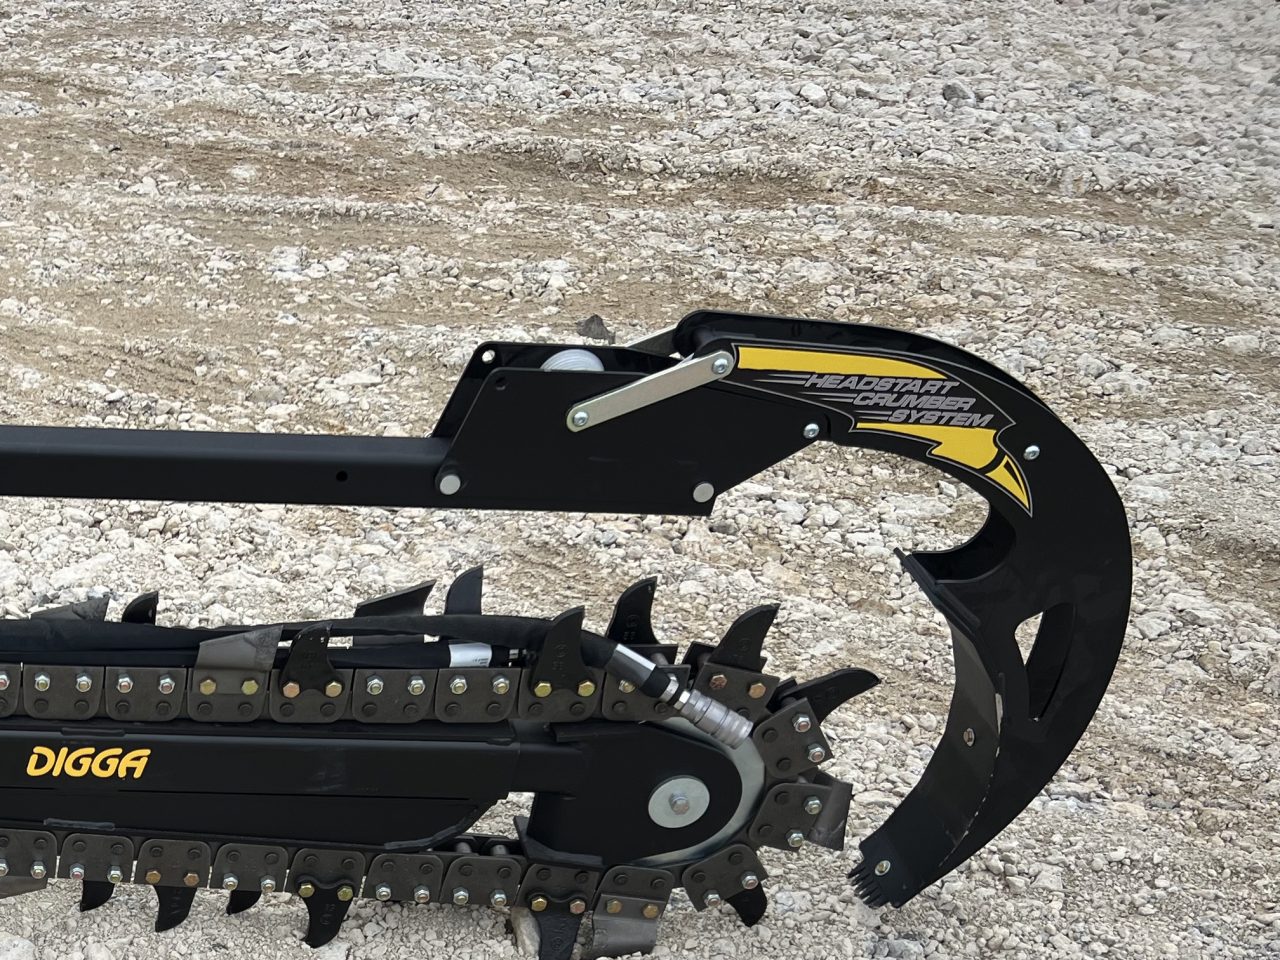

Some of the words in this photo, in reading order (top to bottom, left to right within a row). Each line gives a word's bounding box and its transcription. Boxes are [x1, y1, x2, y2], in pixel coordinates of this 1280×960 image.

[804, 374, 960, 395] HEADSTART
[851, 392, 977, 412] CRUMBER
[887, 409, 995, 427] SYSTEM
[26, 745, 151, 779] DIGGA
